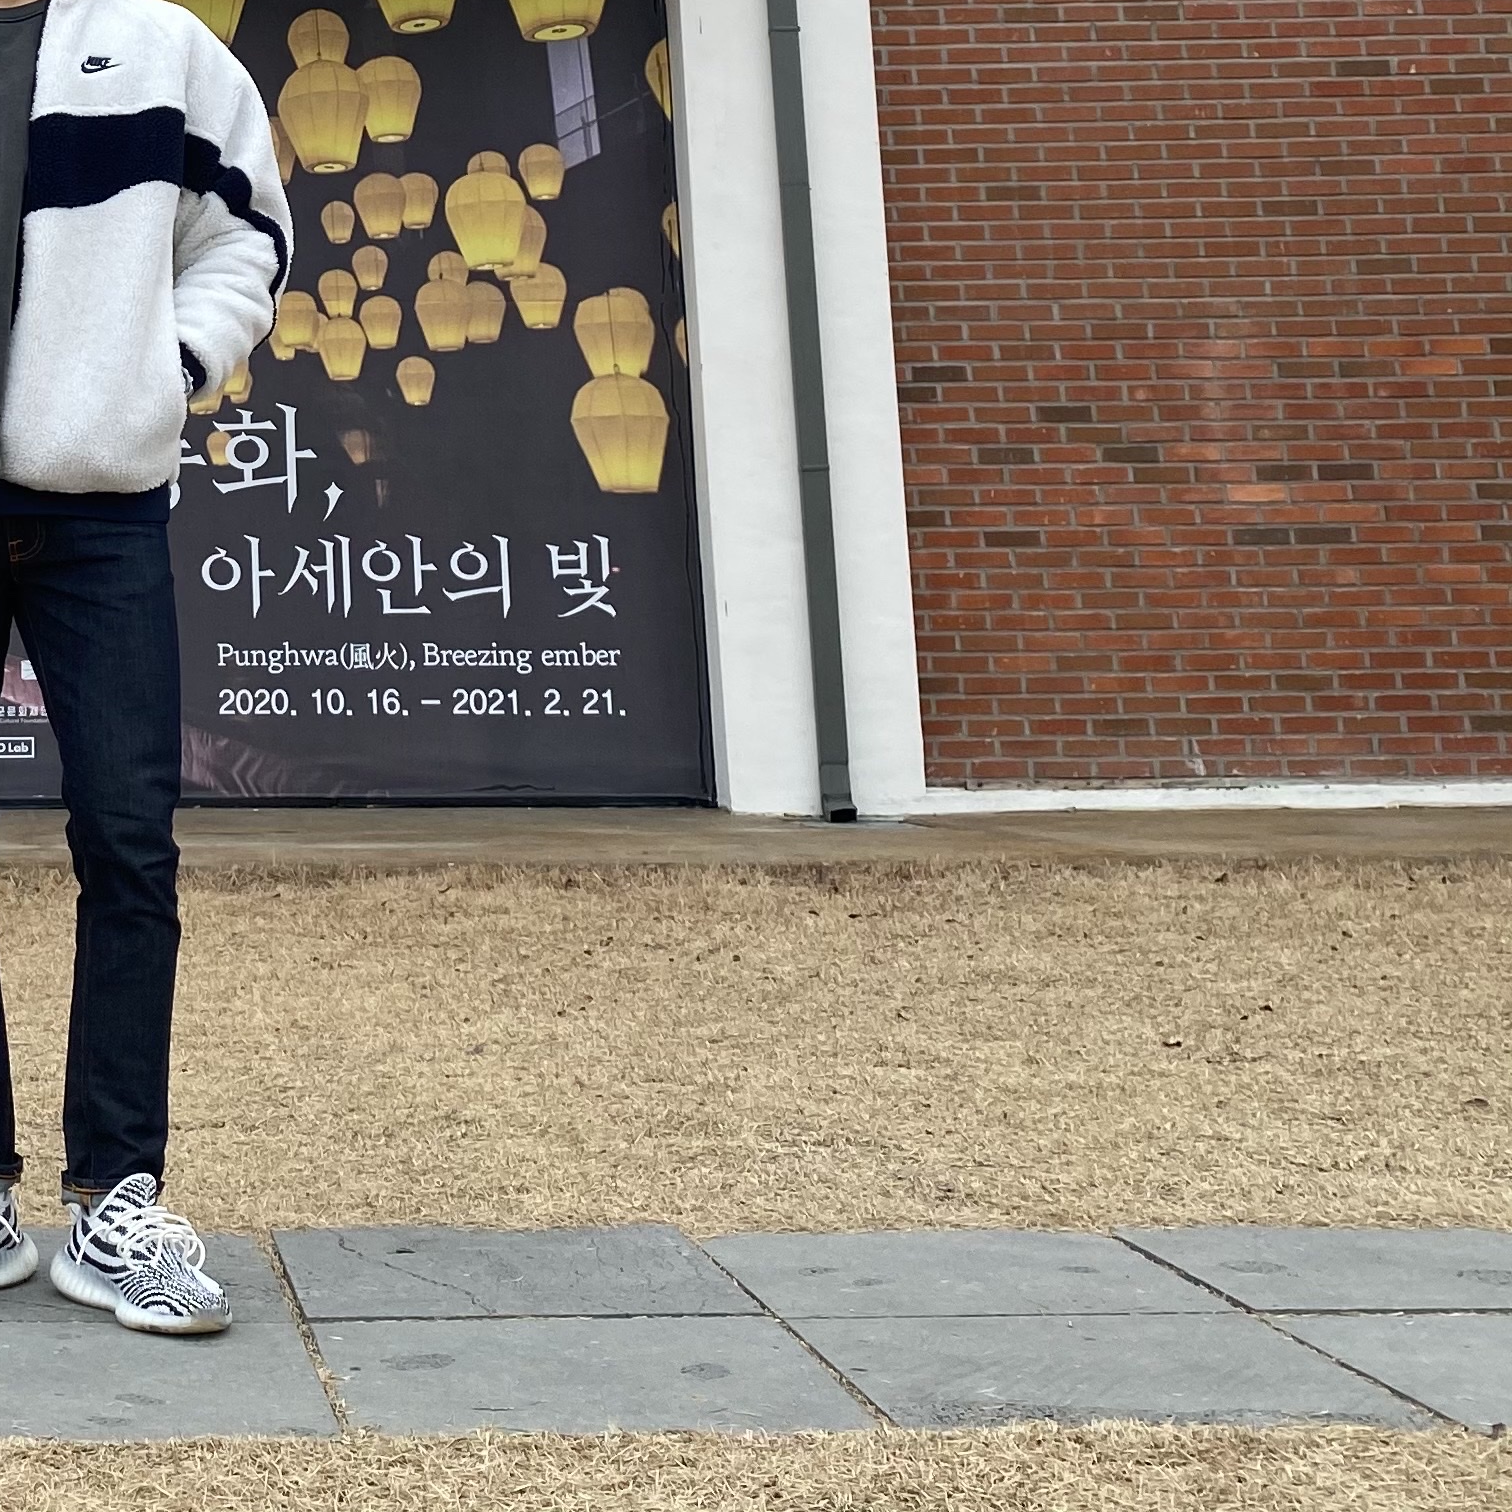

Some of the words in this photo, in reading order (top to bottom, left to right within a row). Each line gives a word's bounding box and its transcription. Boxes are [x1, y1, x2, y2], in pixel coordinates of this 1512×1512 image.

[201, 534, 511, 619] 아세안의
[545, 534, 618, 619] 빛
[217, 642, 416, 673] Punghwa(風火),
[422, 642, 533, 675] Breezing
[541, 642, 621, 667] ember
[218, 688, 297, 717] 2020.
[311, 688, 353, 717] 10.
[367, 688, 409, 717] 16.
[452, 688, 532, 717] 2021.
[543, 688, 570, 717] 2.
[582, 688, 626, 717] 21.
[8, 741, 29, 753] Lab
